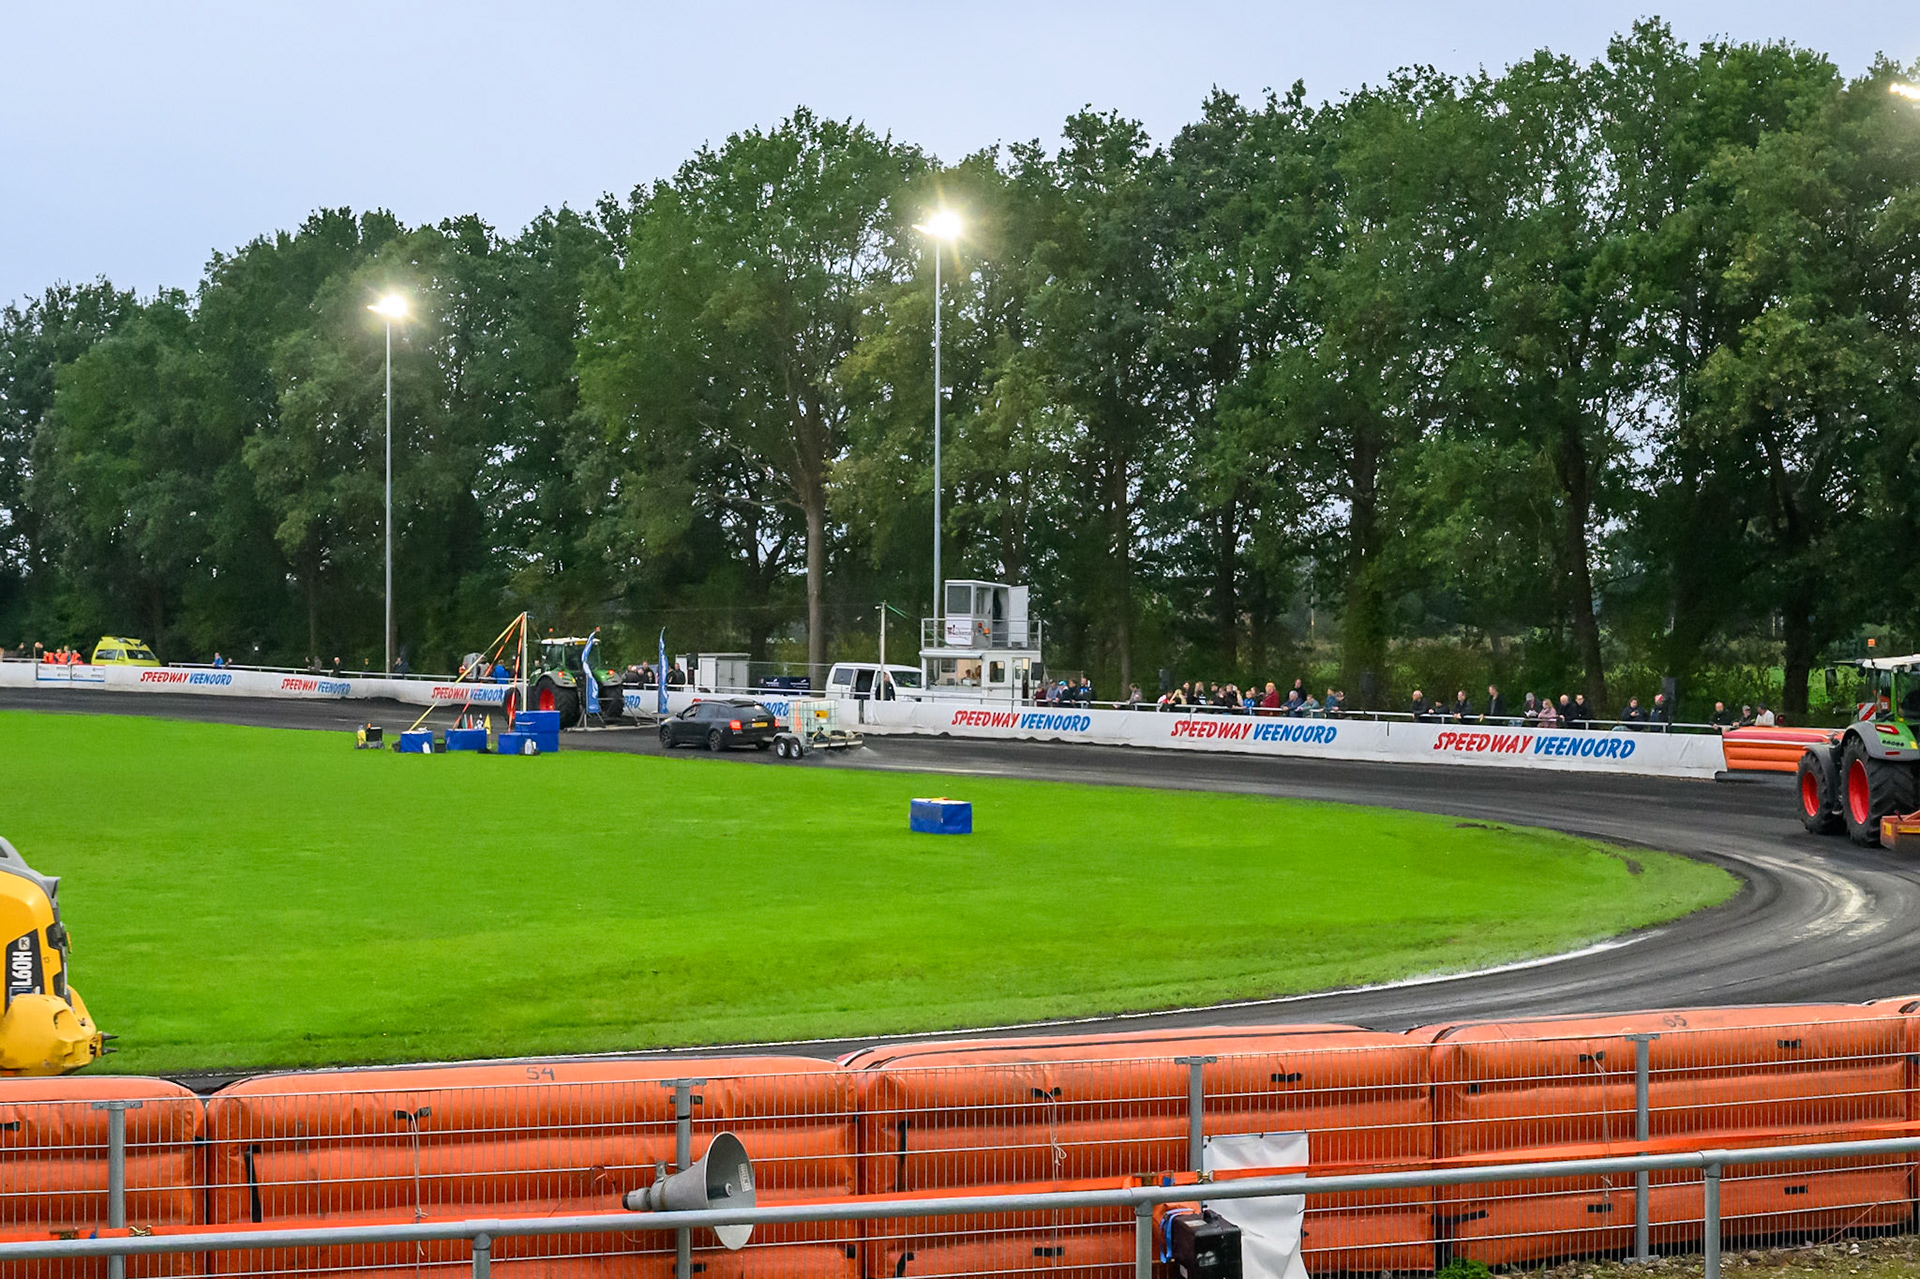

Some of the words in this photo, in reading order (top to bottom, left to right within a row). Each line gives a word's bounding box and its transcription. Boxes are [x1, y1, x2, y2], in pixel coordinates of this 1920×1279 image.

[141, 671, 189, 683] SPEEDWAY
[189, 673, 233, 686] VEENOORD
[281, 678, 318, 691] SPEEDWAY
[317, 681, 351, 695] VEENOORD
[431, 686, 470, 700] SPEEDWAY
[952, 709, 1020, 728] SPEEDWAY
[1020, 713, 1091, 732] VEENOORD
[1171, 719, 1253, 740] SPEEDWAY
[1253, 723, 1338, 745] VEENOORD
[1434, 731, 1534, 754] SPEEDWAY
[1534, 736, 1636, 759] VEENOORD
[12, 951, 33, 986] L60H
[526, 1066, 555, 1081] 54
